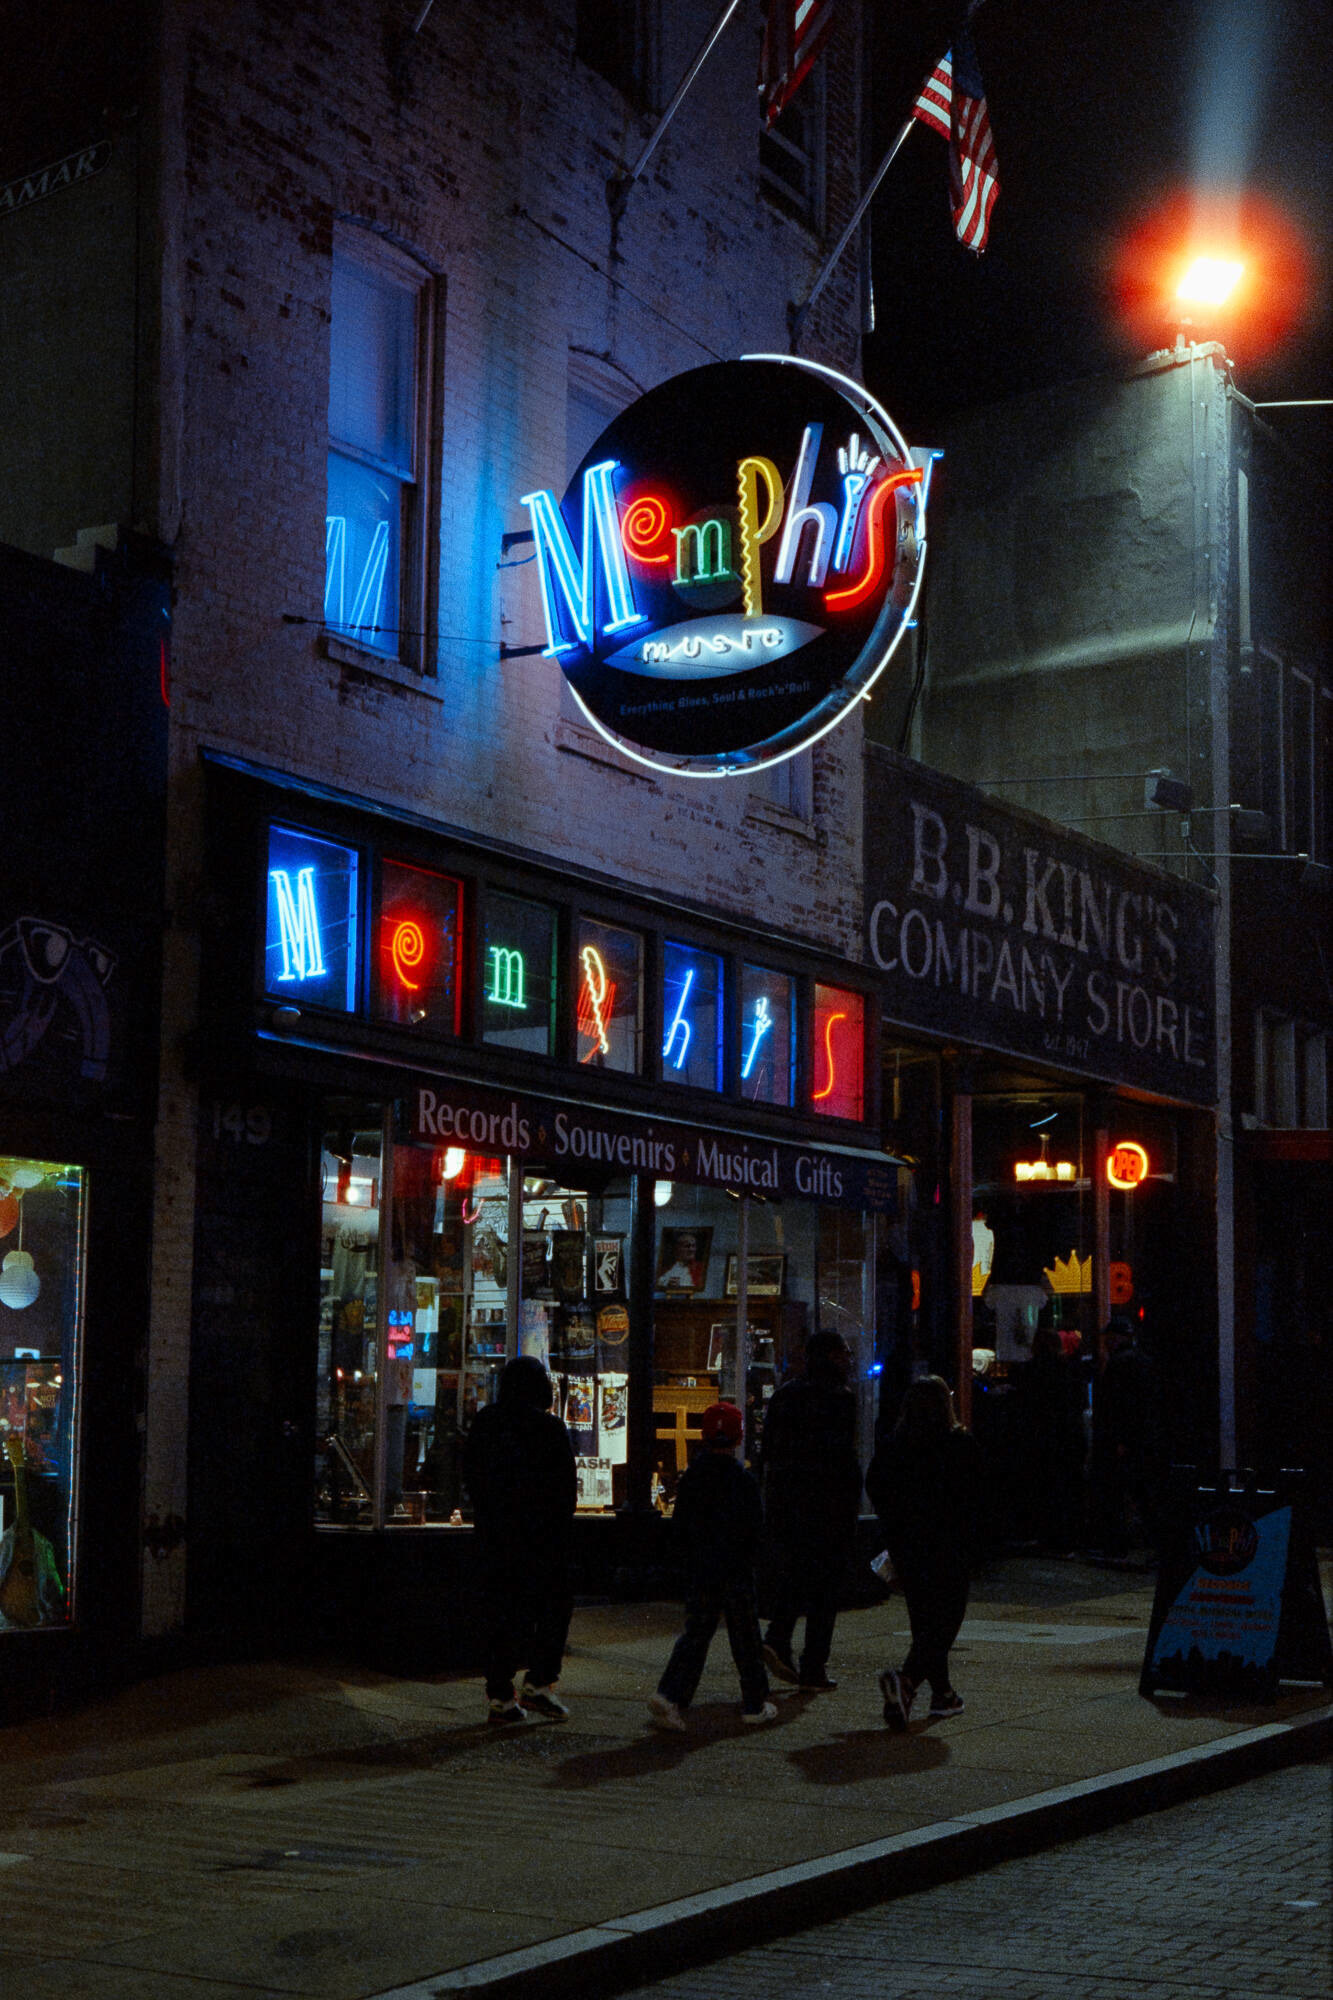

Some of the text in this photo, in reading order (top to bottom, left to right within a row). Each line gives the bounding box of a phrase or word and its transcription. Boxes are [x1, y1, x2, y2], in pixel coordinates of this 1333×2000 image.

[520, 421, 923, 658] Memphis
[641, 627, 785, 664] music
[619, 699, 675, 716] Everything
[713, 690, 736, 704] Soul
[737, 688, 746, 700] &
[869, 900, 1206, 1067] COMPANY STORE
[418, 1088, 531, 1150] Records
[554, 1112, 676, 1173] Souvenirs
[696, 1138, 780, 1189] Musical
[795, 1156, 844, 1198] Gifts
